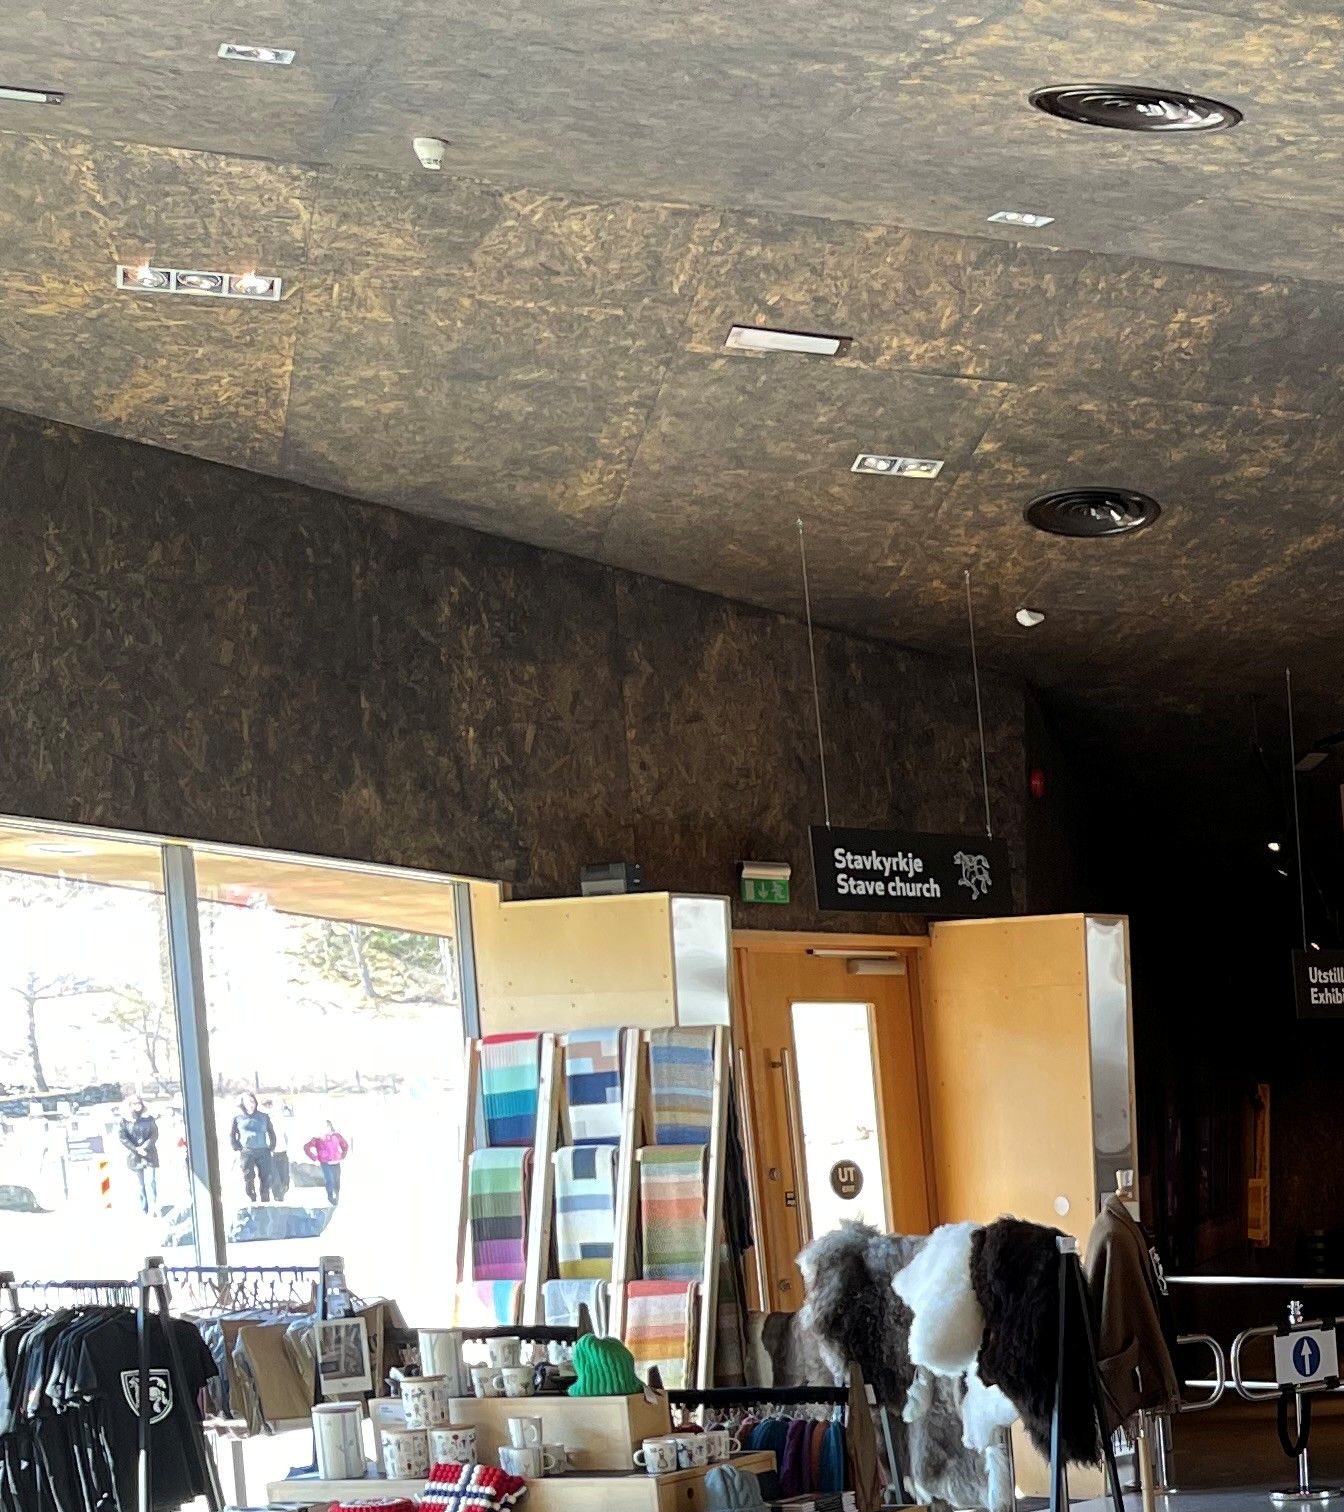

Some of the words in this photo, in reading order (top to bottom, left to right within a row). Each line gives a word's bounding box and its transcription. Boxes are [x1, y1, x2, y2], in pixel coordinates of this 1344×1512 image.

[834, 848, 923, 878] Stavkyrkje
[836, 873, 885, 895] Stave
[887, 876, 941, 898] church
[837, 1167, 856, 1182] UT
